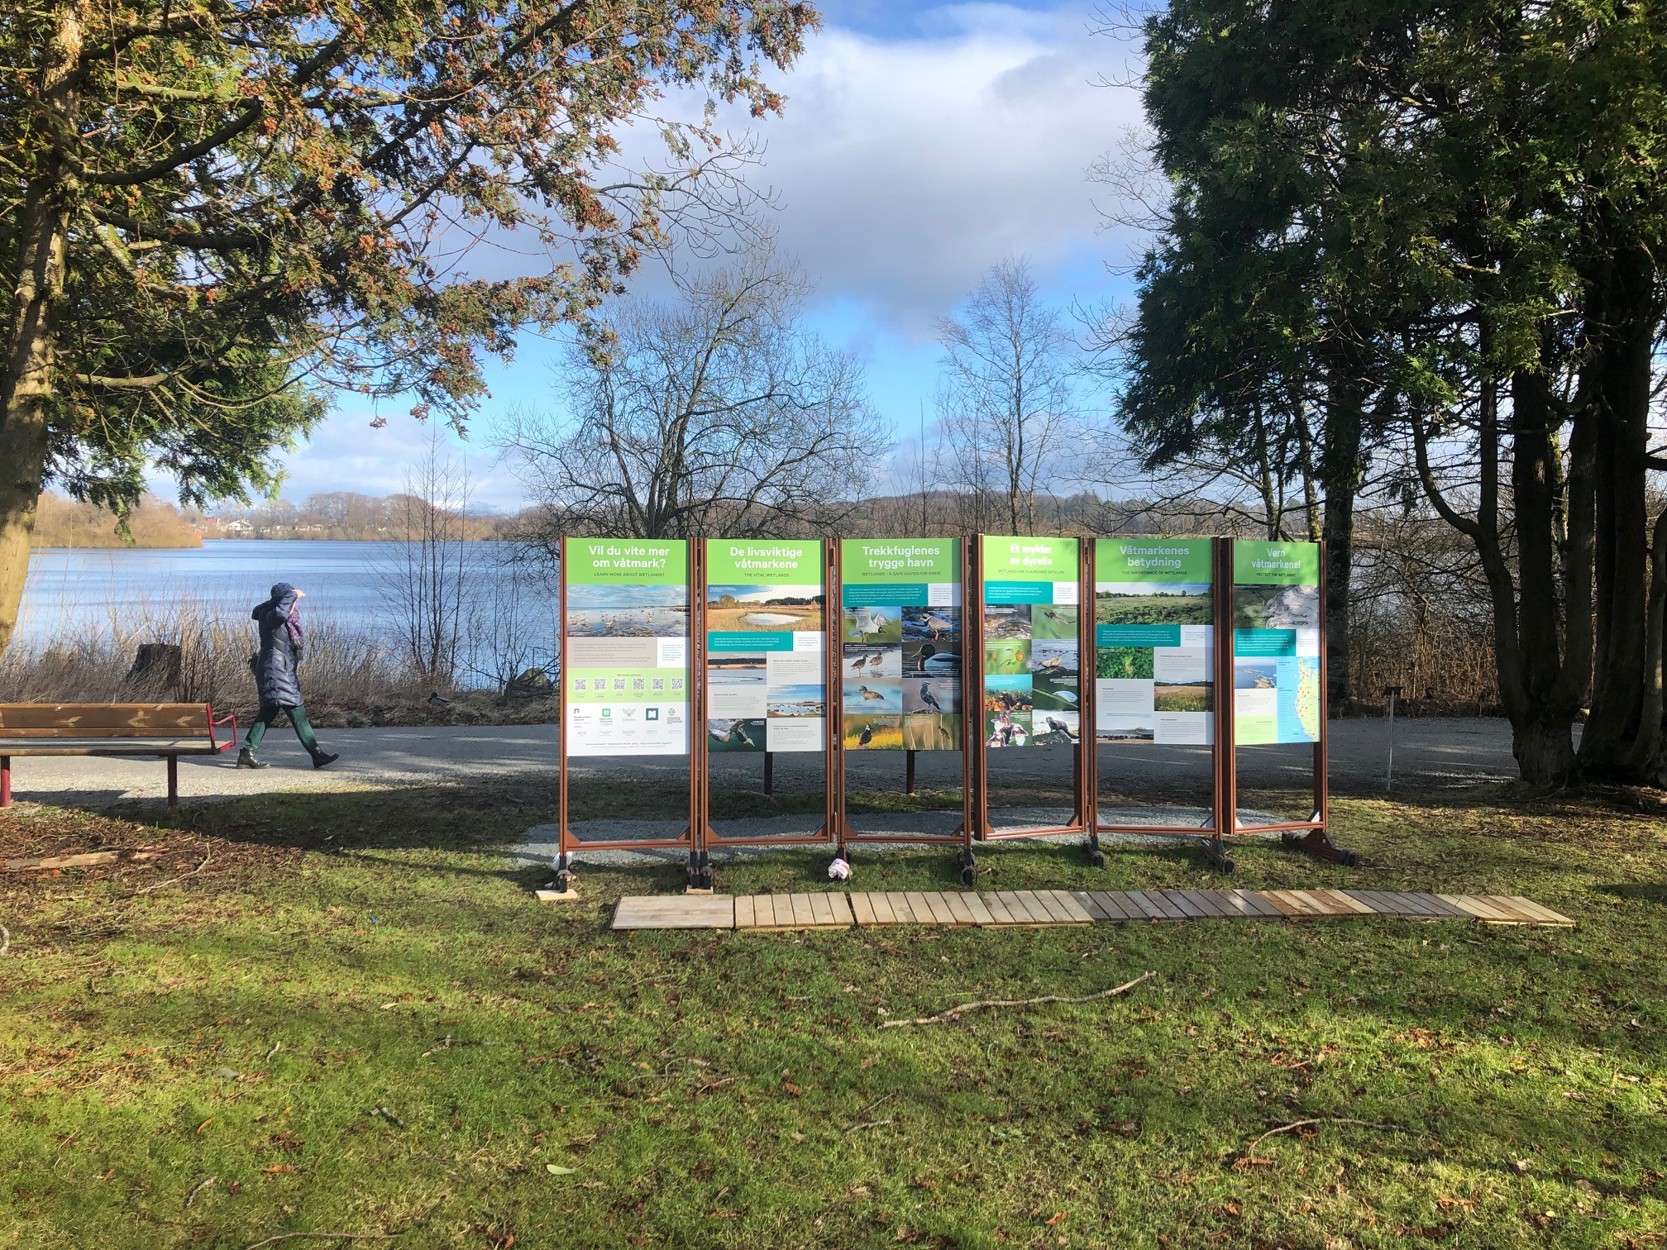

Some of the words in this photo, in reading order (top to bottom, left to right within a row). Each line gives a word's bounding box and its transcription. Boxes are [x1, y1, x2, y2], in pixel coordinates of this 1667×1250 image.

[588, 545, 603, 556] Vil
[606, 545, 621, 556] du
[624, 545, 646, 556] vite
[648, 548, 670, 556] mer
[729, 546, 745, 557] De
[747, 546, 803, 558] livsviktige
[862, 545, 940, 557] Trekkfuglenes
[1119, 545, 1190, 555] Våtmarkenes
[1266, 548, 1286, 558] Vern
[592, 560, 610, 568] om
[613, 558, 667, 568] våtmark?
[734, 558, 799, 569] våtmarkene
[868, 558, 905, 569] trygge
[907, 557, 934, 567] havn
[1127, 557, 1182, 569] betydning
